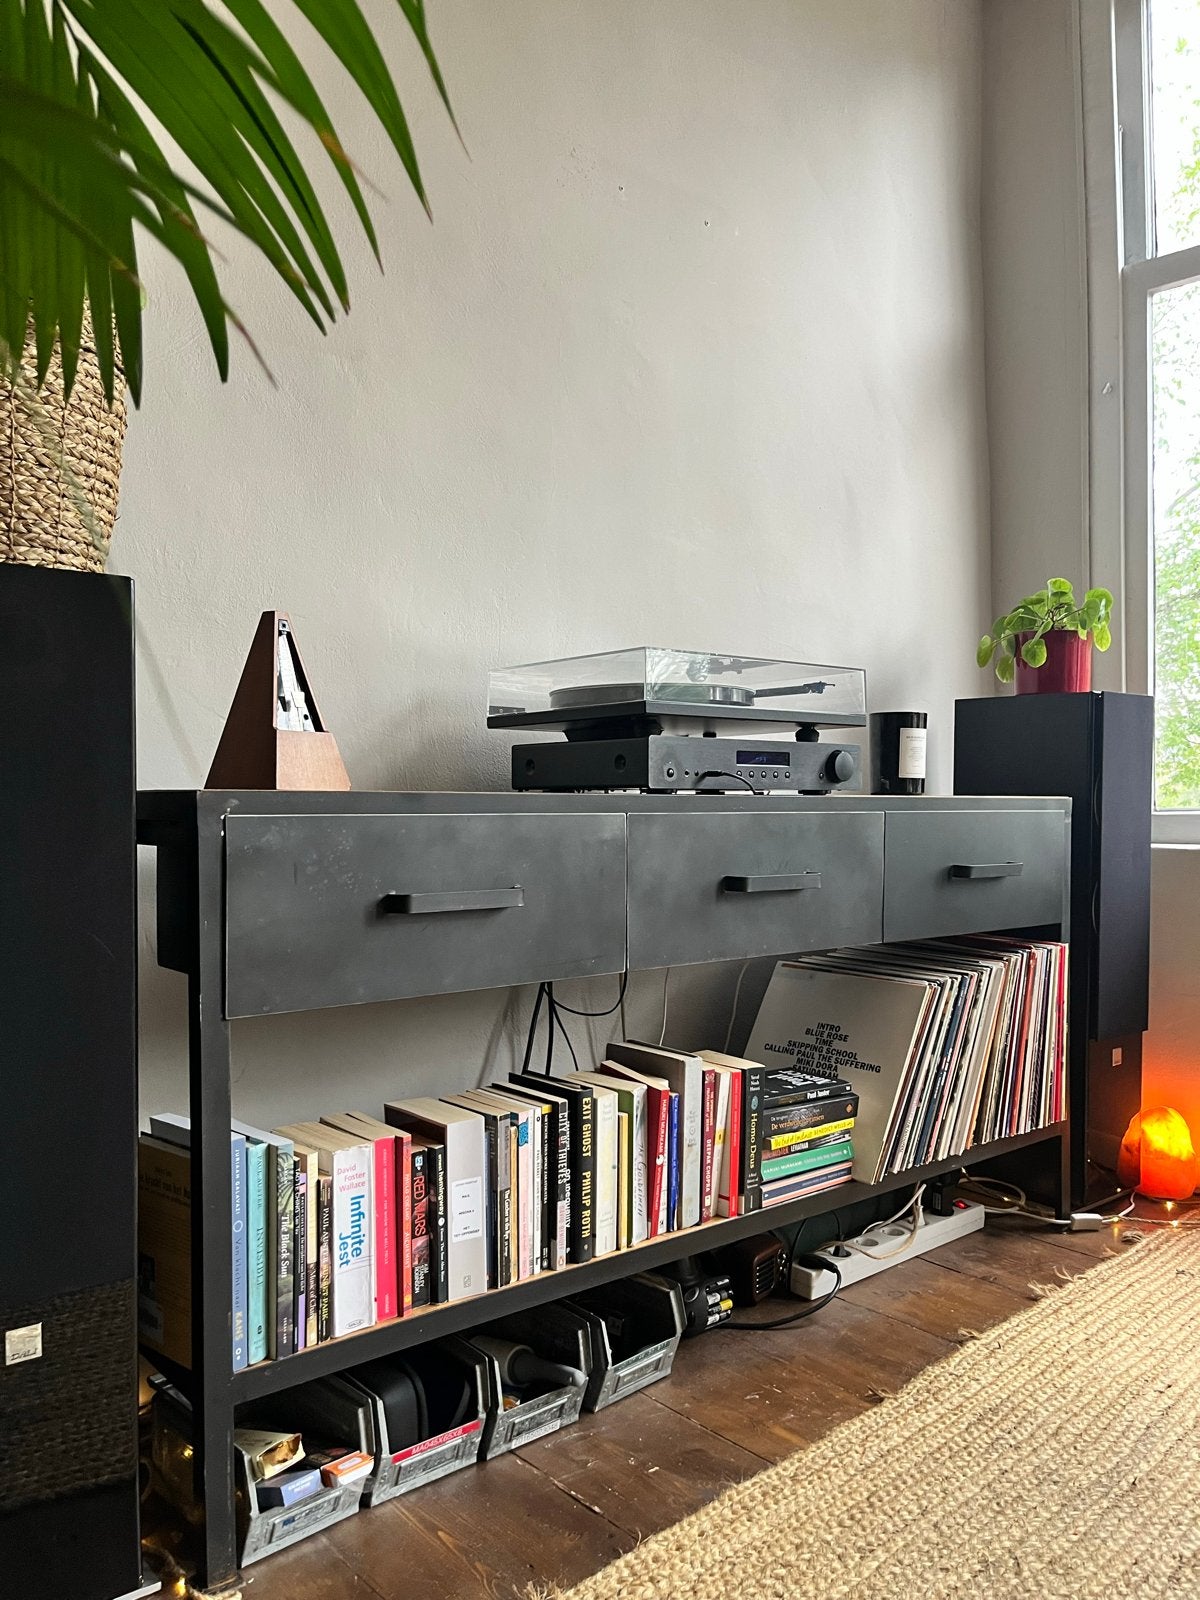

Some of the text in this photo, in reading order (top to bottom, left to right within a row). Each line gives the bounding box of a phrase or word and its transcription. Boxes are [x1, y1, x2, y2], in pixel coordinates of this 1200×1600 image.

[805, 1028, 849, 1043] BLUE ROSE
[817, 1022, 841, 1033] INTRO
[787, 1040, 858, 1060] SKIPPING SCHOOL
[815, 1037, 834, 1048] TIME
[764, 1043, 881, 1074] CALLING PAUL THE SUFFERING
[796, 1058, 838, 1073] MIKI DORA
[807, 1092, 816, 1100] Paul
[559, 1112, 567, 1131] CITY
[750, 1113, 758, 1143] Homo
[561, 1136, 567, 1145] OF
[658, 1121, 666, 1153] MURAKAMI
[558, 1147, 567, 1184] THIEVES
[749, 1145, 757, 1169] Deus
[337, 1164, 357, 1175] David
[344, 1171, 366, 1182] Foster
[581, 1097, 592, 1238] EXIT GHOST PHILIP ROTH
[295, 1183, 300, 1191] TE
[339, 1181, 366, 1192] Wallace
[413, 1175, 425, 1200] RED
[437, 1171, 445, 1215] hemingway
[281, 1214, 289, 1232] The
[351, 1195, 366, 1258] Infinite
[414, 1202, 426, 1237] MARS
[281, 1234, 289, 1259] Black
[339, 1232, 351, 1268] Jest
[281, 1260, 289, 1278] Sun
[310, 1290, 317, 1298] of
[235, 1311, 243, 1341] KANS
